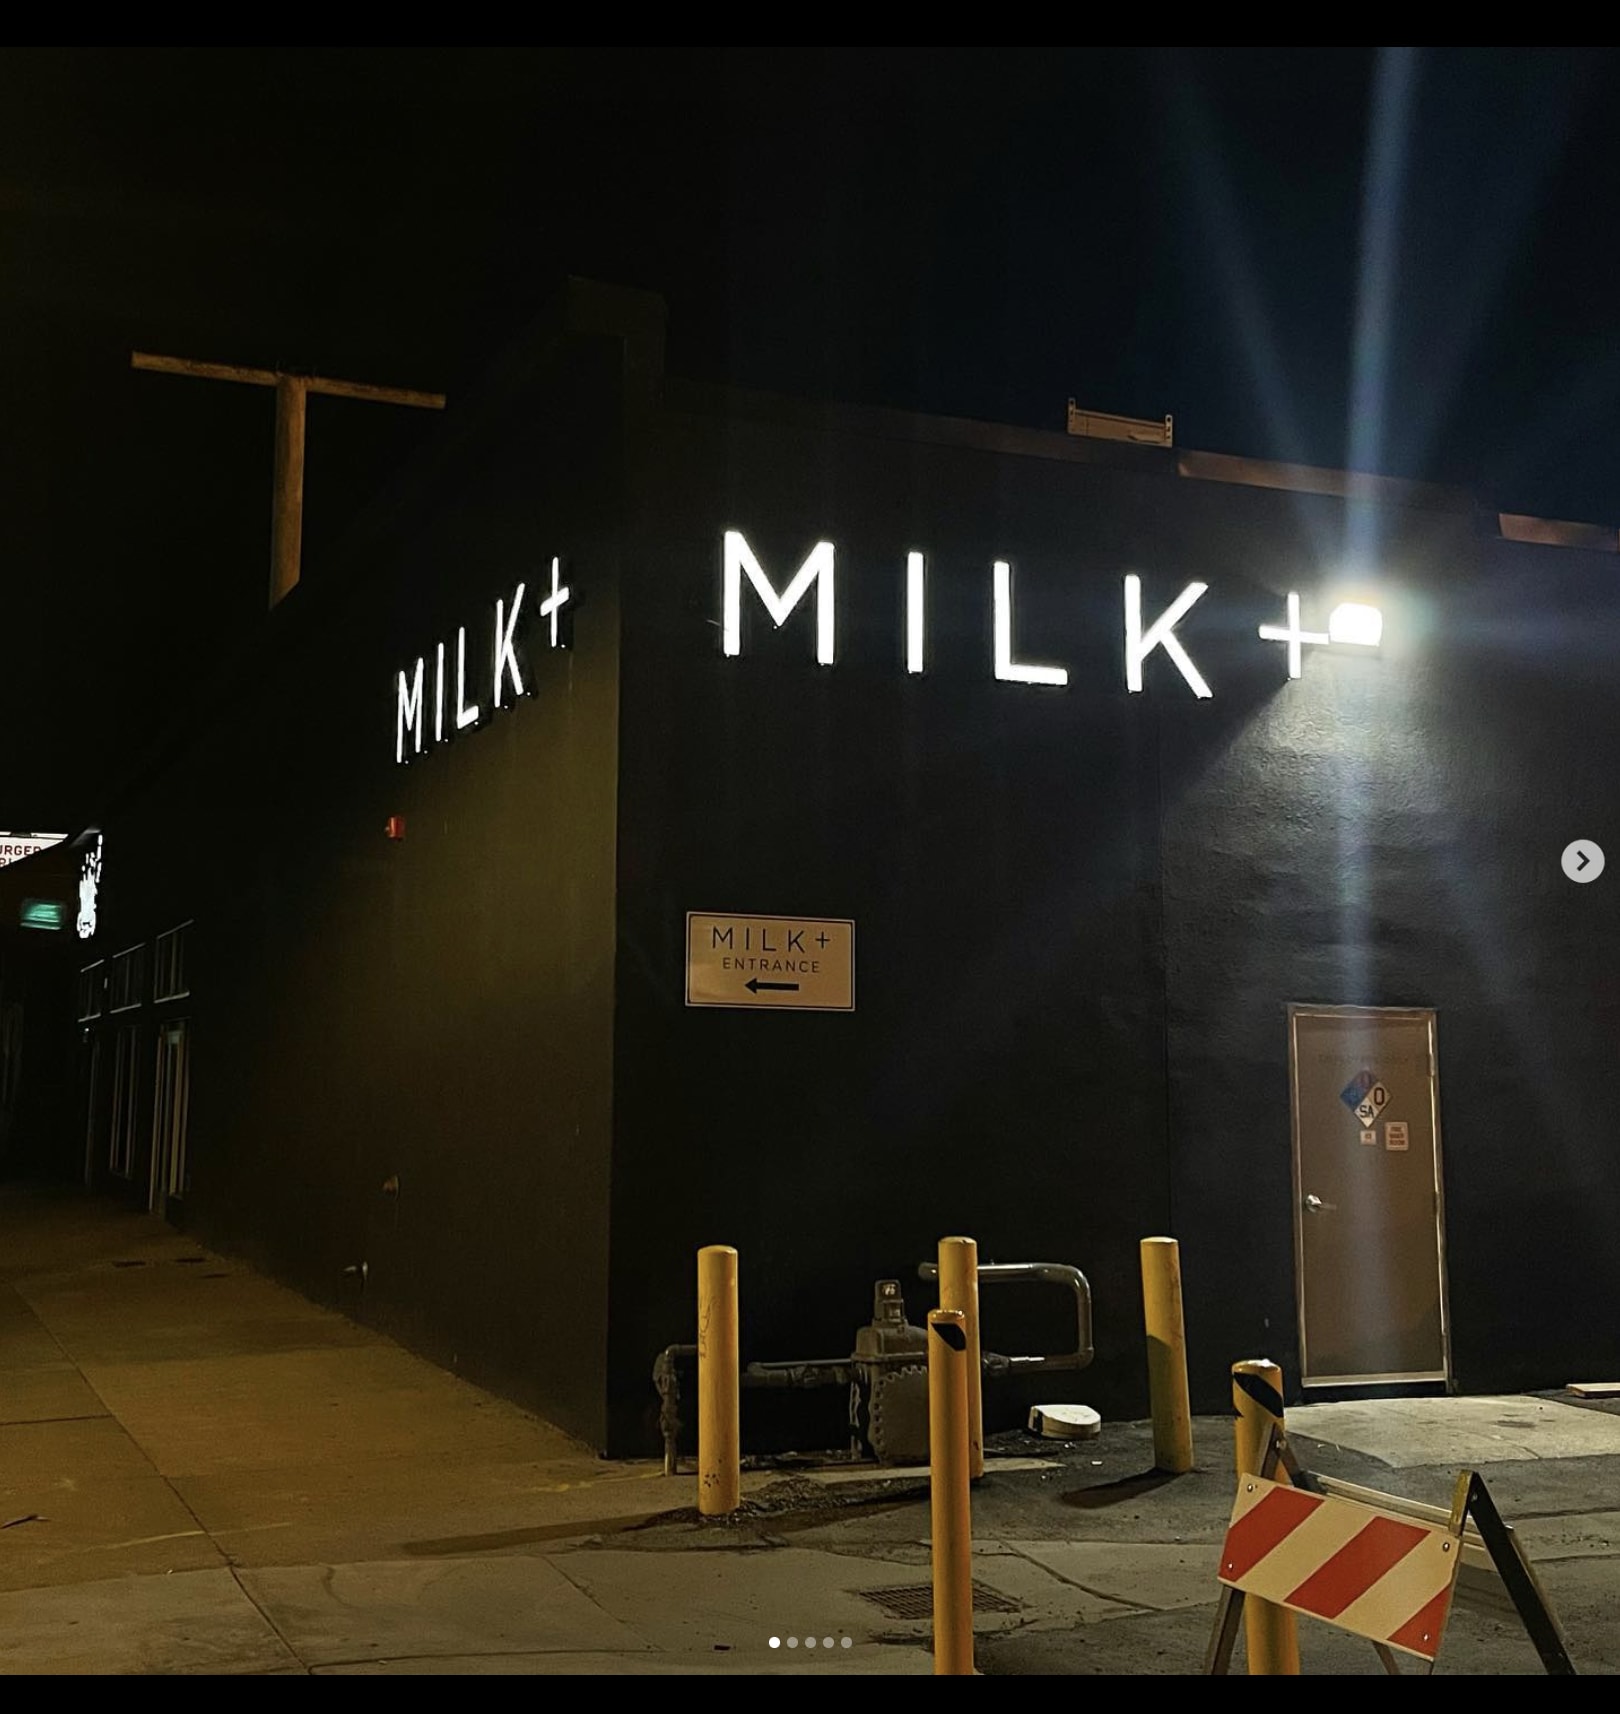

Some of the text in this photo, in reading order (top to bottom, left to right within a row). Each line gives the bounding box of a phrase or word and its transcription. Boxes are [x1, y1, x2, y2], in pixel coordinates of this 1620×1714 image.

[722, 529, 1329, 699] MILK+
[396, 556, 570, 763] MILK+
[712, 926, 831, 954] MILK+
[722, 956, 821, 974] ENTRANCE
[1359, 1104, 1375, 1119] SA
